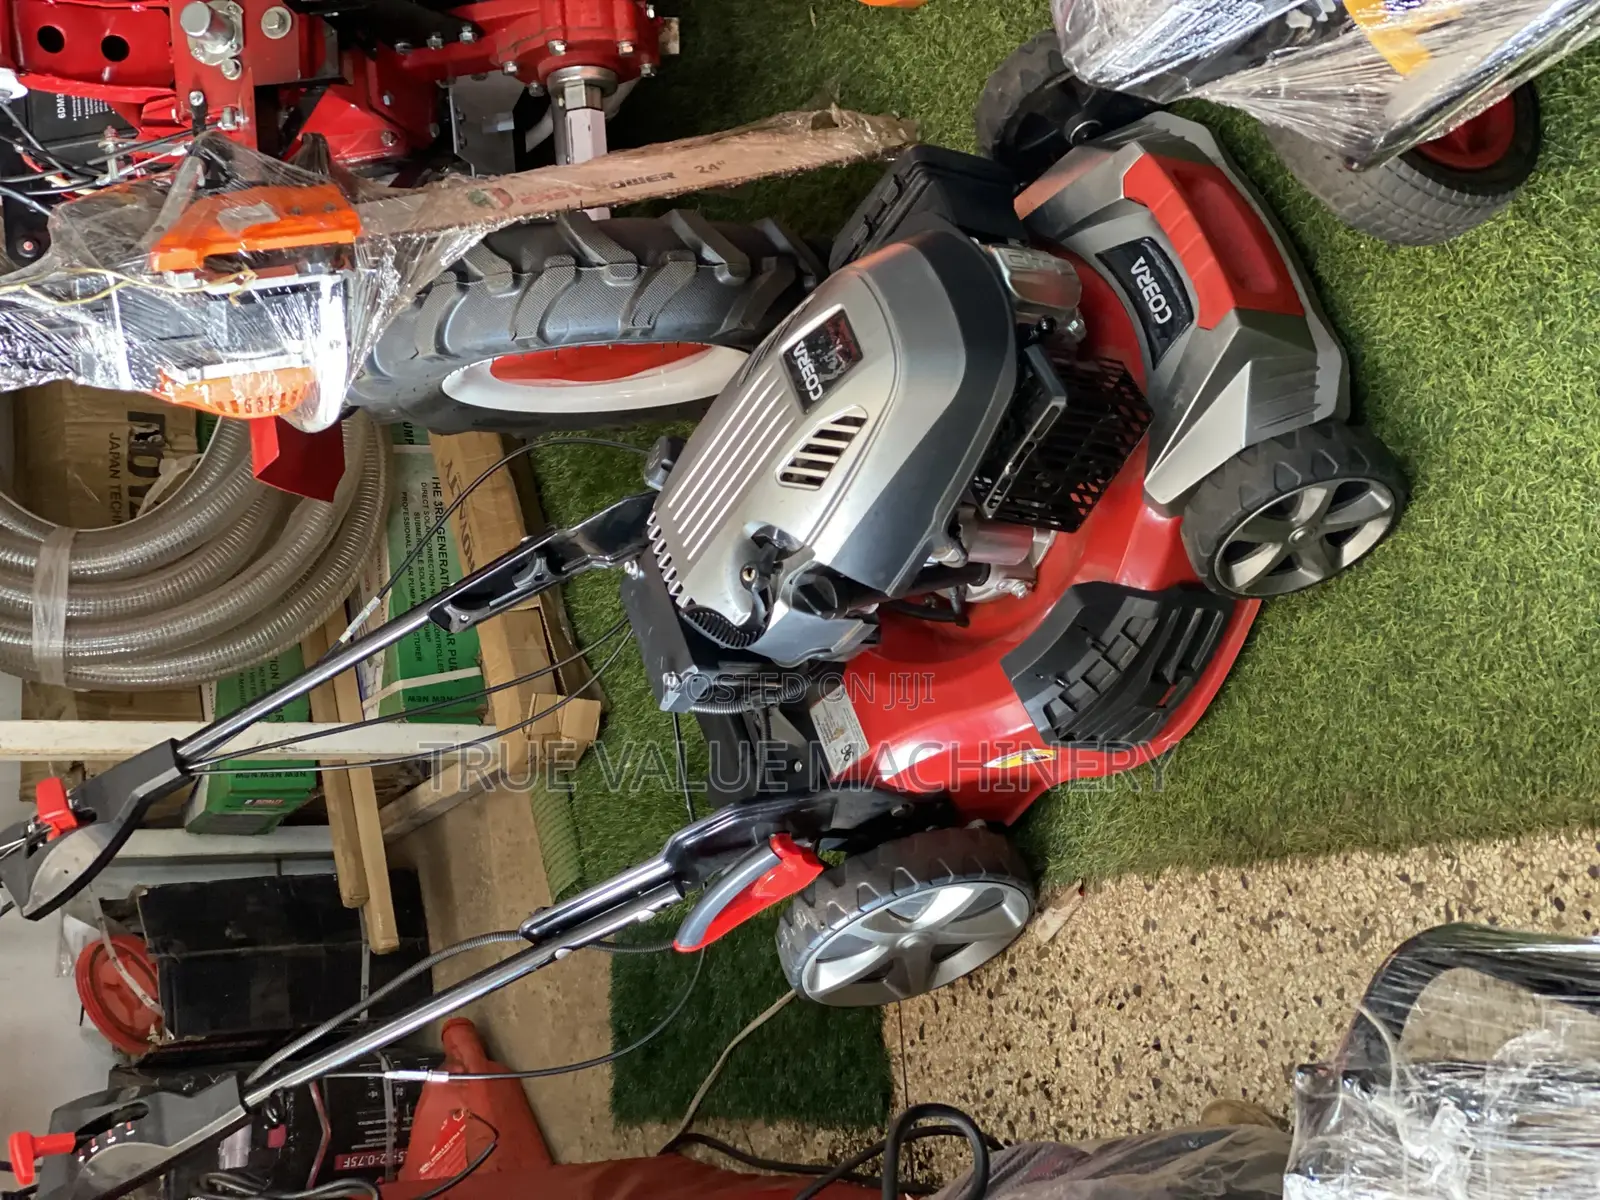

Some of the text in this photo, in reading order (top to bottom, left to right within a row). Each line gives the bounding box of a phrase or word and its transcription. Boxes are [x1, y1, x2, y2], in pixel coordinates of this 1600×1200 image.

[1131, 255, 1173, 325] COBRA
[793, 340, 824, 402] COBRA
[109, 431, 122, 479] JAPAN
[402, 421, 415, 445] UMP
[421, 482, 430, 509] DIRECT
[401, 491, 413, 549] PROFESSIONAL
[407, 695, 429, 703] NEW
